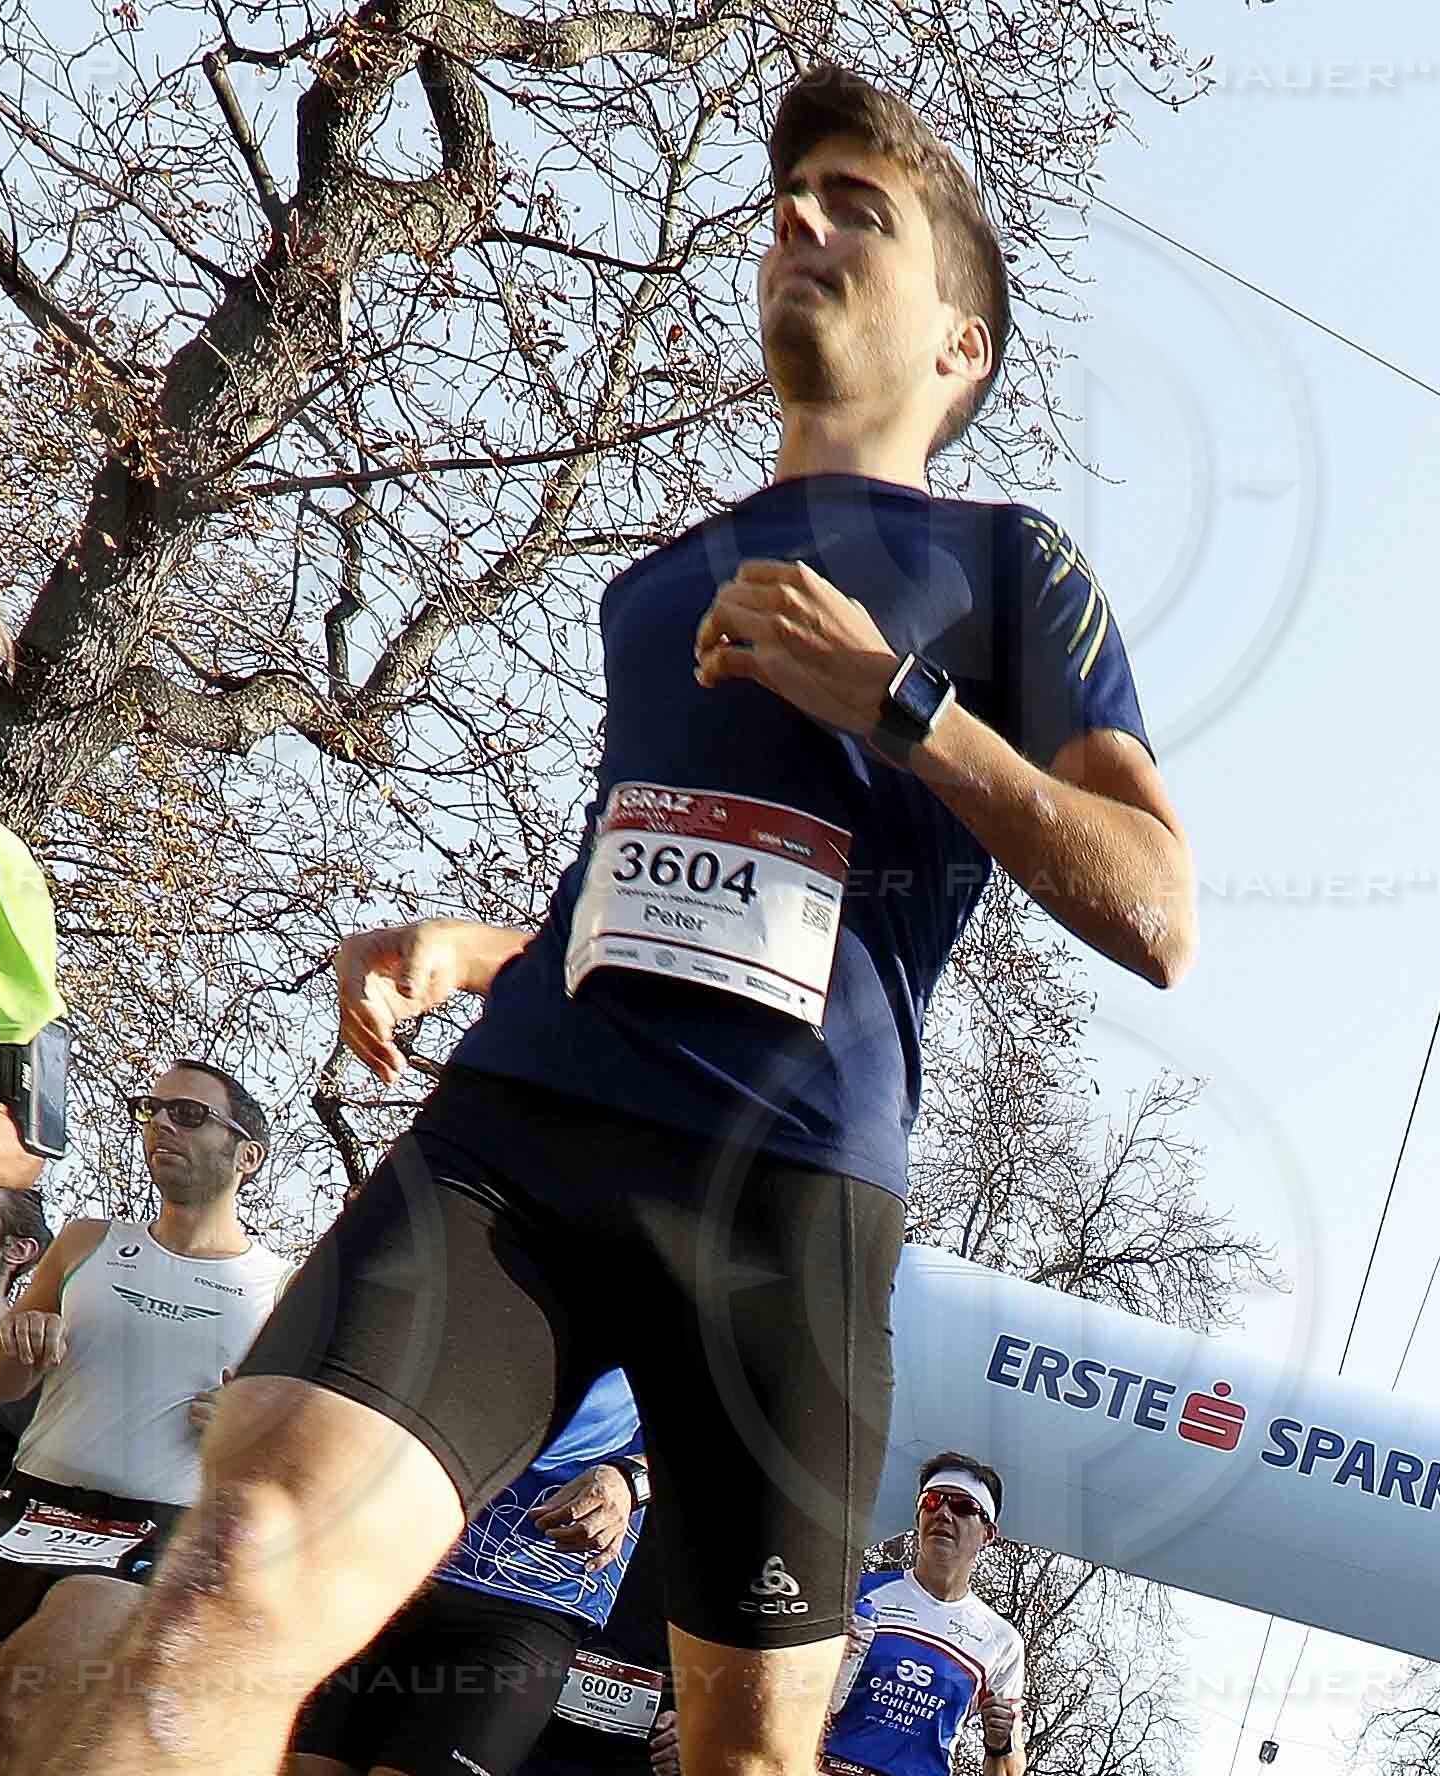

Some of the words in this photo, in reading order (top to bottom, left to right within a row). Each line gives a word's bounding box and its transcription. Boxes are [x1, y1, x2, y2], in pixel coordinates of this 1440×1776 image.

[611, 841, 758, 906] 3604
[643, 903, 710, 934] Peter
[146, 1297, 180, 1316] TRI
[984, 1333, 1178, 1433] ERSTE
[44, 1529, 111, 1548] 2147
[581, 1675, 634, 1704] 6003
[885, 1708, 914, 1727] BAU
